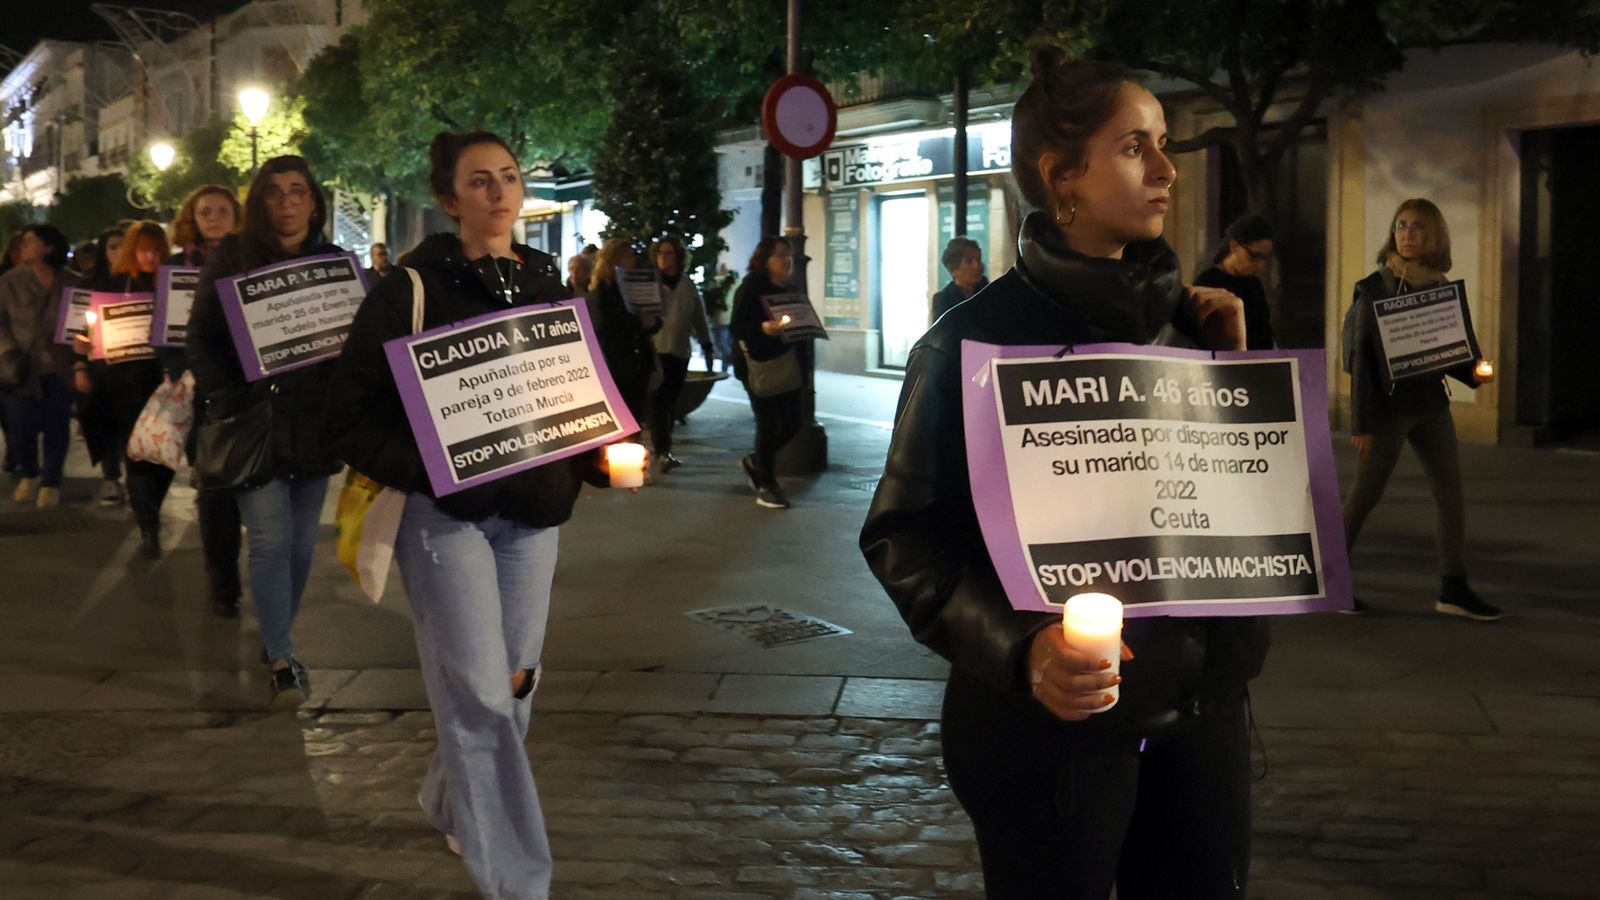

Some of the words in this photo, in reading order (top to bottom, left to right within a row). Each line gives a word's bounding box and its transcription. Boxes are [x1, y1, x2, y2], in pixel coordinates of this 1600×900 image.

[246, 277, 286, 296] SARA
[287, 274, 299, 286] P.
[300, 271, 312, 282] Y.
[313, 268, 327, 279] 38
[267, 290, 322, 312] Apuñalada
[324, 288, 338, 298] por
[1383, 297, 1419, 311] RAQUEL
[252, 312, 292, 330] marido
[293, 307, 307, 319] 25
[308, 305, 321, 315] de
[322, 300, 348, 312] Enero
[281, 319, 317, 336] Tudela
[262, 349, 291, 364] STOP
[290, 336, 340, 356] VIOLENCIA
[418, 331, 510, 370] CLAUDIA
[512, 328, 529, 344] A.
[531, 322, 546, 339] 17
[549, 319, 579, 338] años
[458, 360, 536, 391] Apuñalada
[538, 358, 556, 372] por
[558, 353, 571, 364] su
[440, 394, 491, 420] pareja
[493, 388, 504, 402] 9
[506, 383, 525, 398] de
[526, 375, 566, 392] febrero
[567, 366, 591, 383] 2022
[1022, 376, 1108, 407] MARI
[1118, 376, 1146, 402] A.
[1152, 377, 1180, 404] 46
[1187, 381, 1250, 408] años
[482, 402, 534, 425] Totana
[535, 390, 574, 410] Murcia
[453, 444, 495, 470] STOP
[496, 425, 561, 452] VIOLENCIA
[560, 410, 613, 438] MACHISTA
[1021, 423, 1136, 448] Asesinada
[1142, 426, 1172, 448] por
[1176, 424, 1250, 449] disparos
[1254, 427, 1288, 450] por
[1052, 457, 1080, 476] su
[1085, 451, 1160, 474] marido
[1164, 452, 1185, 472] 14
[1188, 452, 1209, 472] de
[1212, 456, 1269, 474] marzo
[1154, 480, 1198, 500] 2022
[1150, 506, 1210, 530] Ceuta
[1038, 562, 1102, 587] STOP
[1106, 556, 1216, 584] VIOLENCIA
[1216, 554, 1312, 578] MACHISTA
